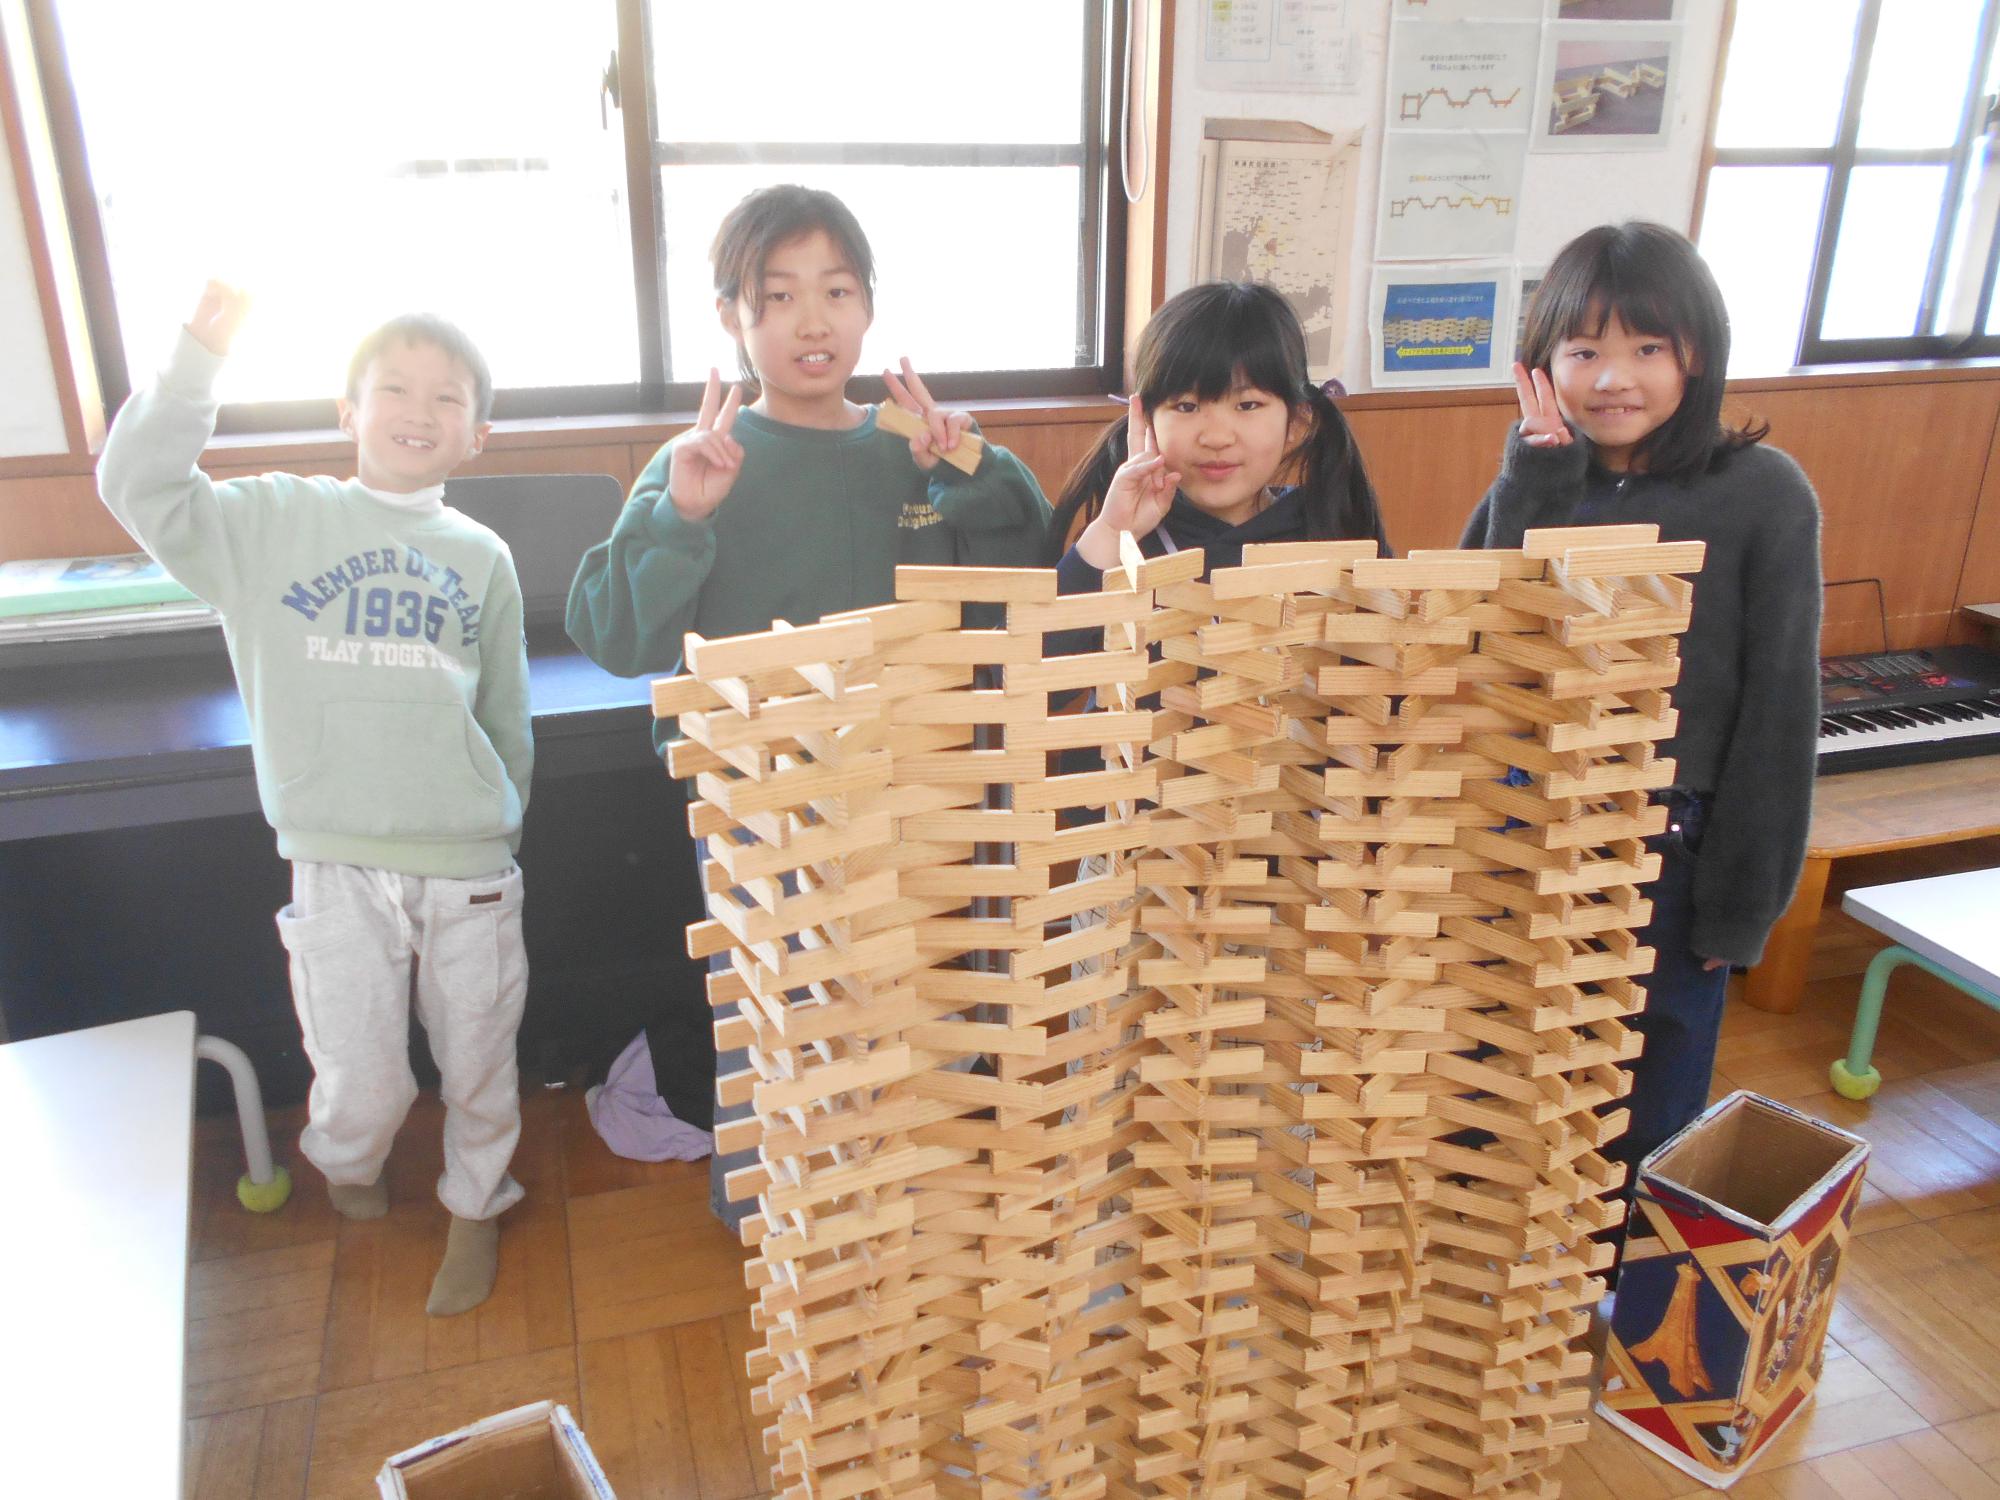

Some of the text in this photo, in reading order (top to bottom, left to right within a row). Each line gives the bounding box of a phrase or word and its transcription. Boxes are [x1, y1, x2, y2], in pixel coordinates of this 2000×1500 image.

[281, 548, 399, 621] MEMBER
[345, 587, 449, 644] 1935
[306, 636, 363, 664] PLAY
